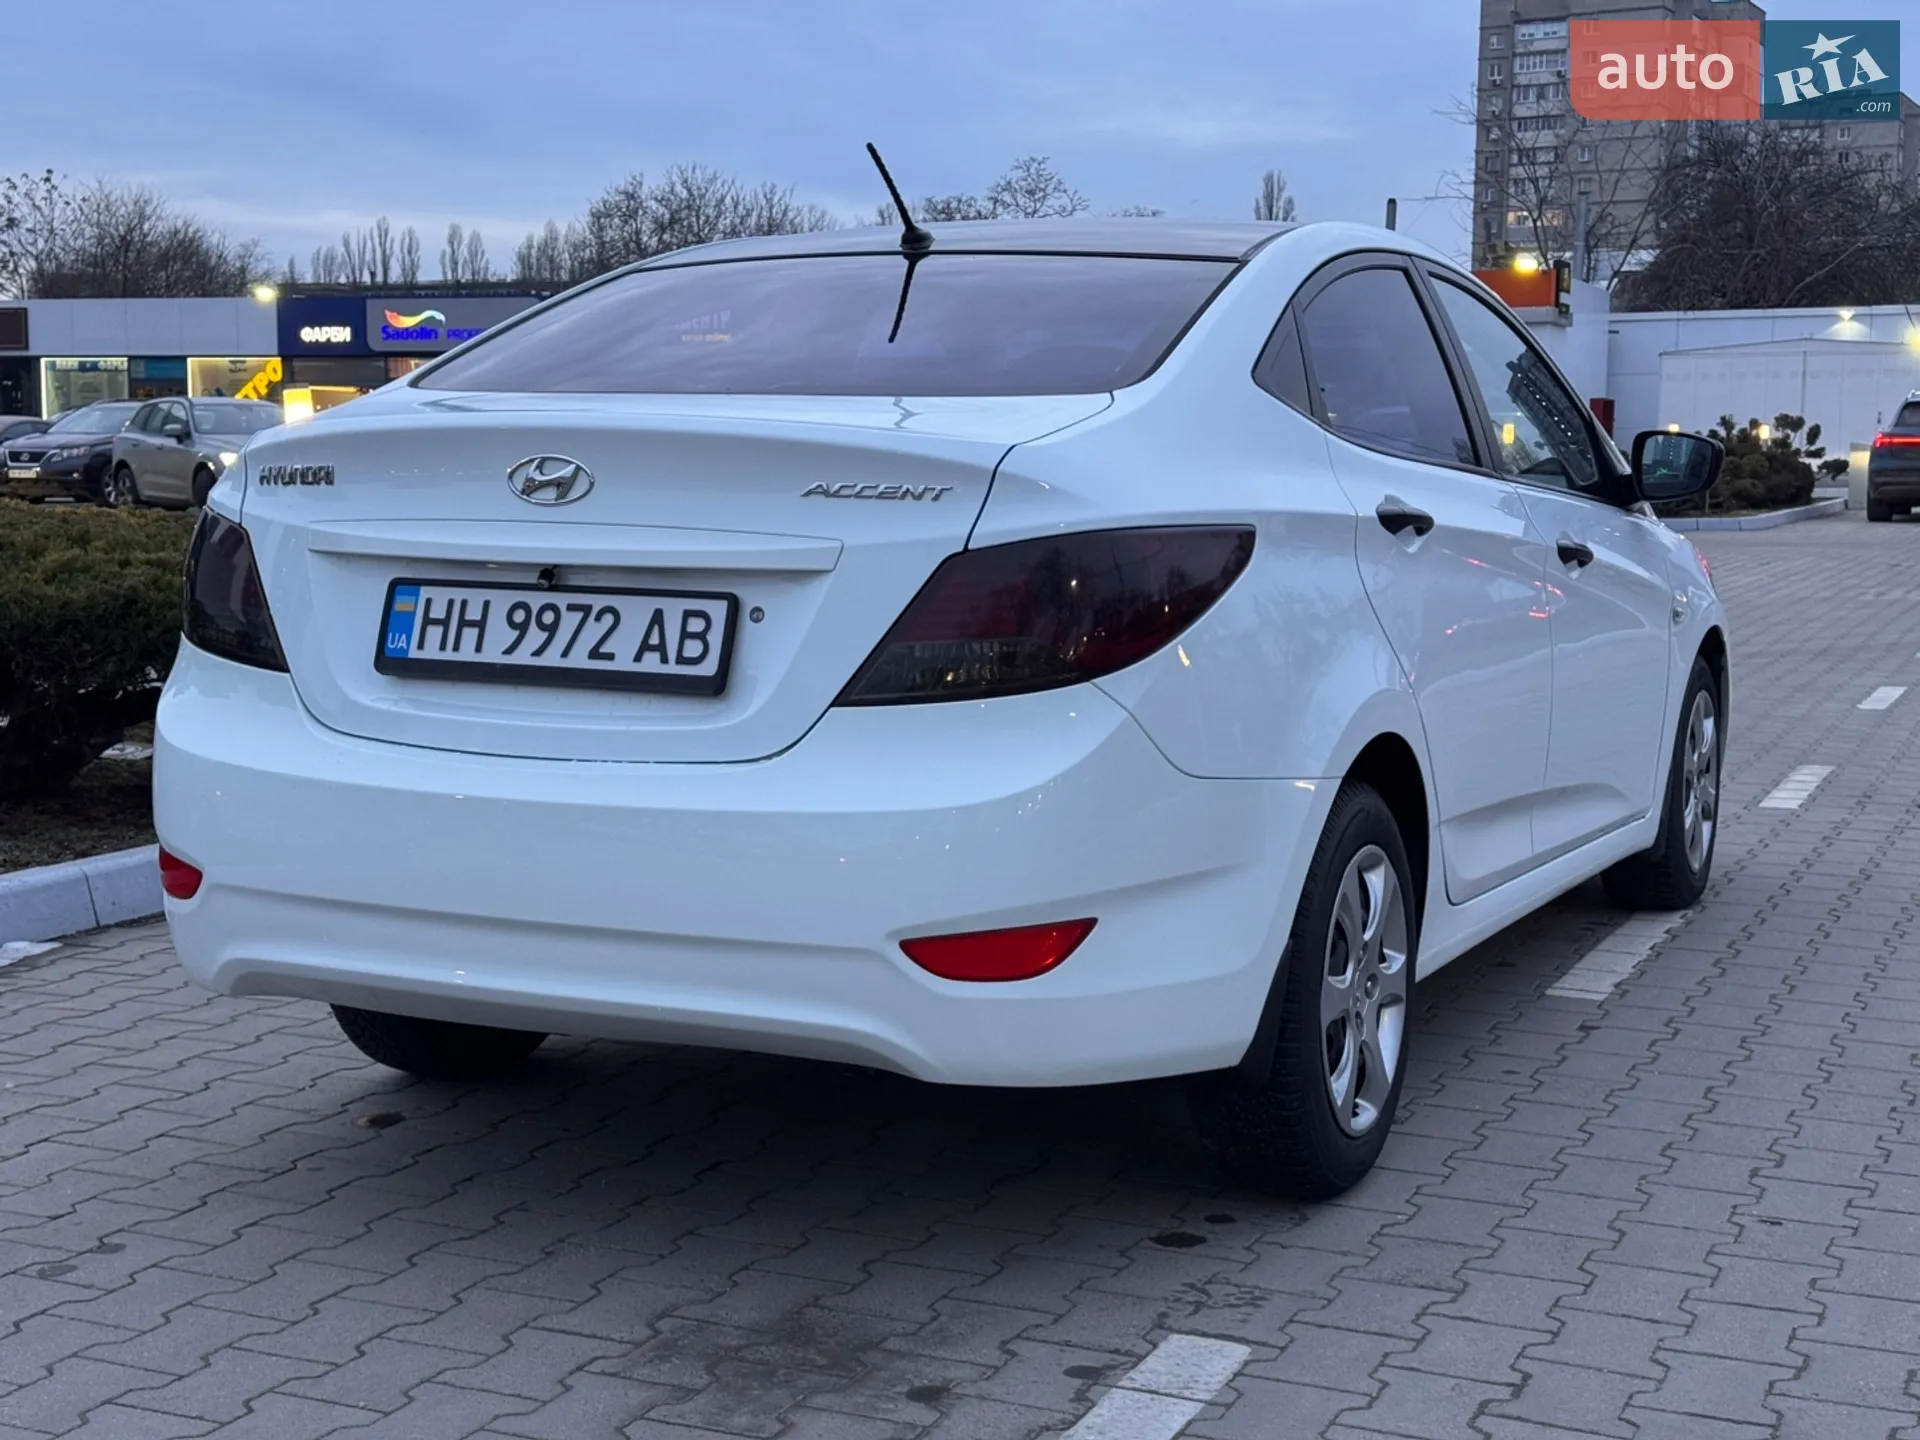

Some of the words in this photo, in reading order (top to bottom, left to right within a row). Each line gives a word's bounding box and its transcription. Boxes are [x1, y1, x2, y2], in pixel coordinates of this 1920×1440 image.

[300, 326, 351, 342] ФАРБИ
[381, 325, 438, 341] Sadolin
[259, 464, 335, 486] HYUNDAI
[801, 481, 953, 502] ACCENT
[388, 632, 408, 650] UA
[416, 597, 491, 654] HH
[501, 600, 622, 661] 9972
[632, 607, 713, 666] AB
